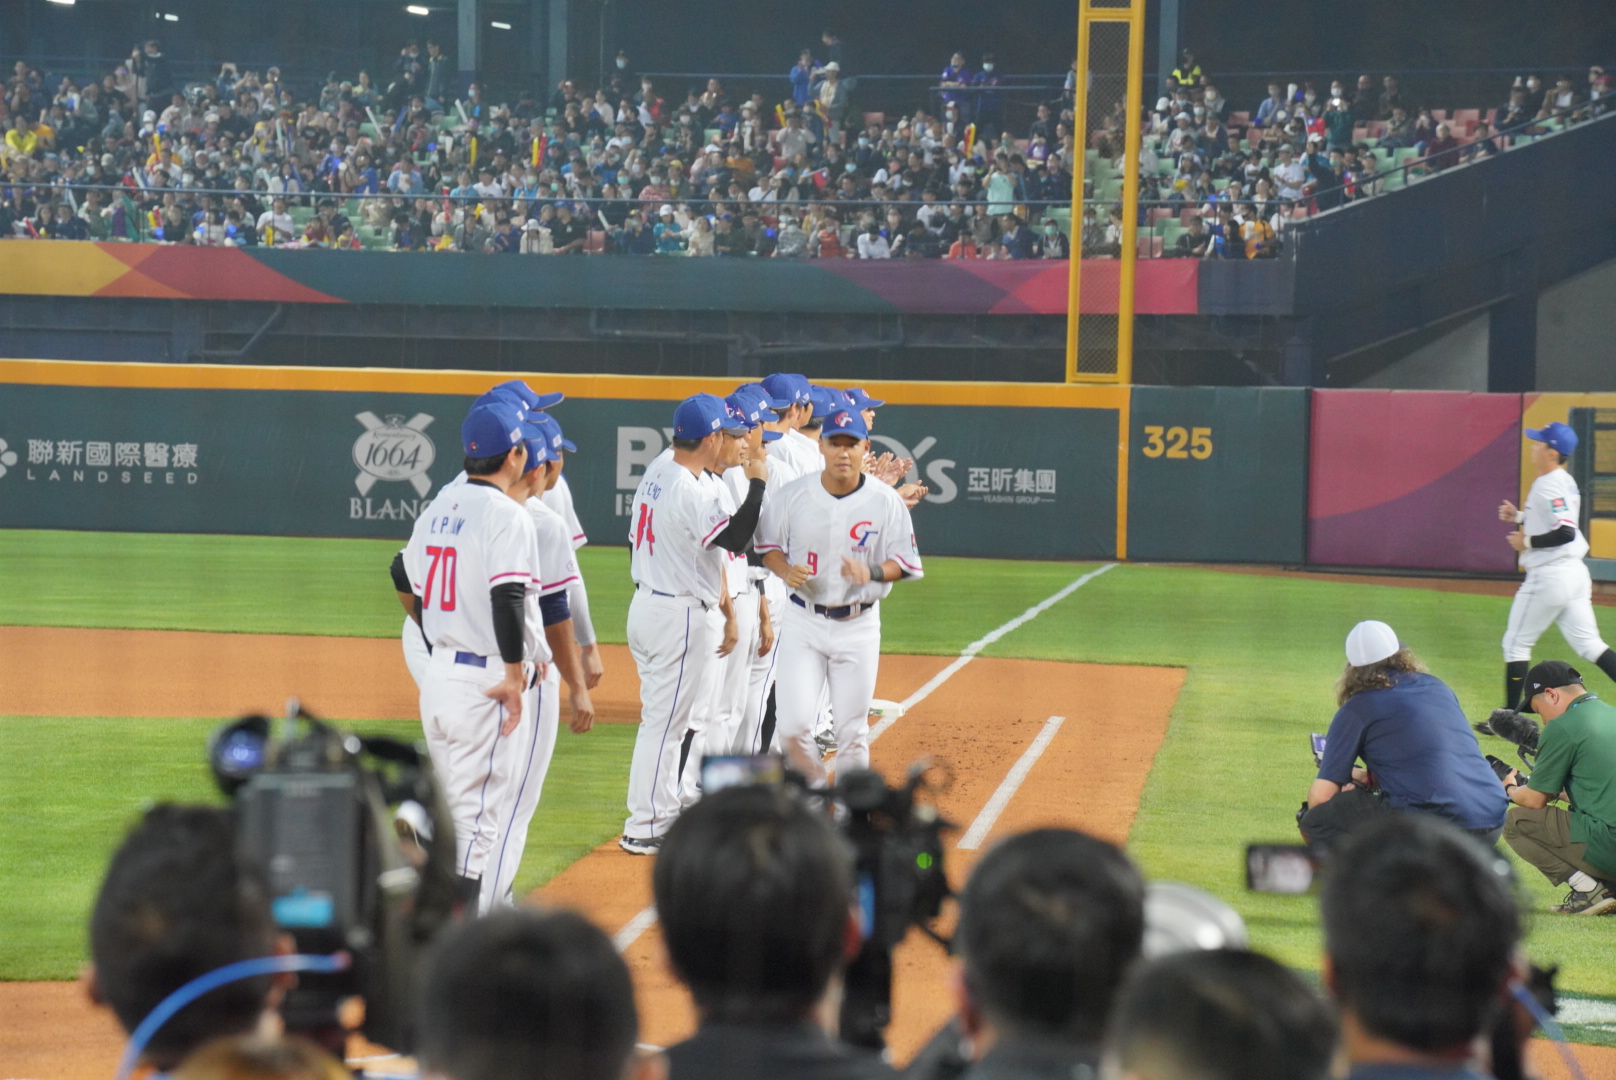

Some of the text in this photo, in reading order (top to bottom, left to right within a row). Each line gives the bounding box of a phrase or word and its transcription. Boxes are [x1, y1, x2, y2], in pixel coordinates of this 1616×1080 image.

[27, 439, 198, 468] 聯新國際醫療
[364, 439, 424, 471] 1664
[1142, 425, 1213, 460] 325
[26, 469, 198, 484] LANDSEED
[967, 467, 1056, 494] 亞昕集團
[1015, 495, 1041, 505] GROUP
[807, 551, 818, 576] 9
[423, 545, 457, 612] 70
